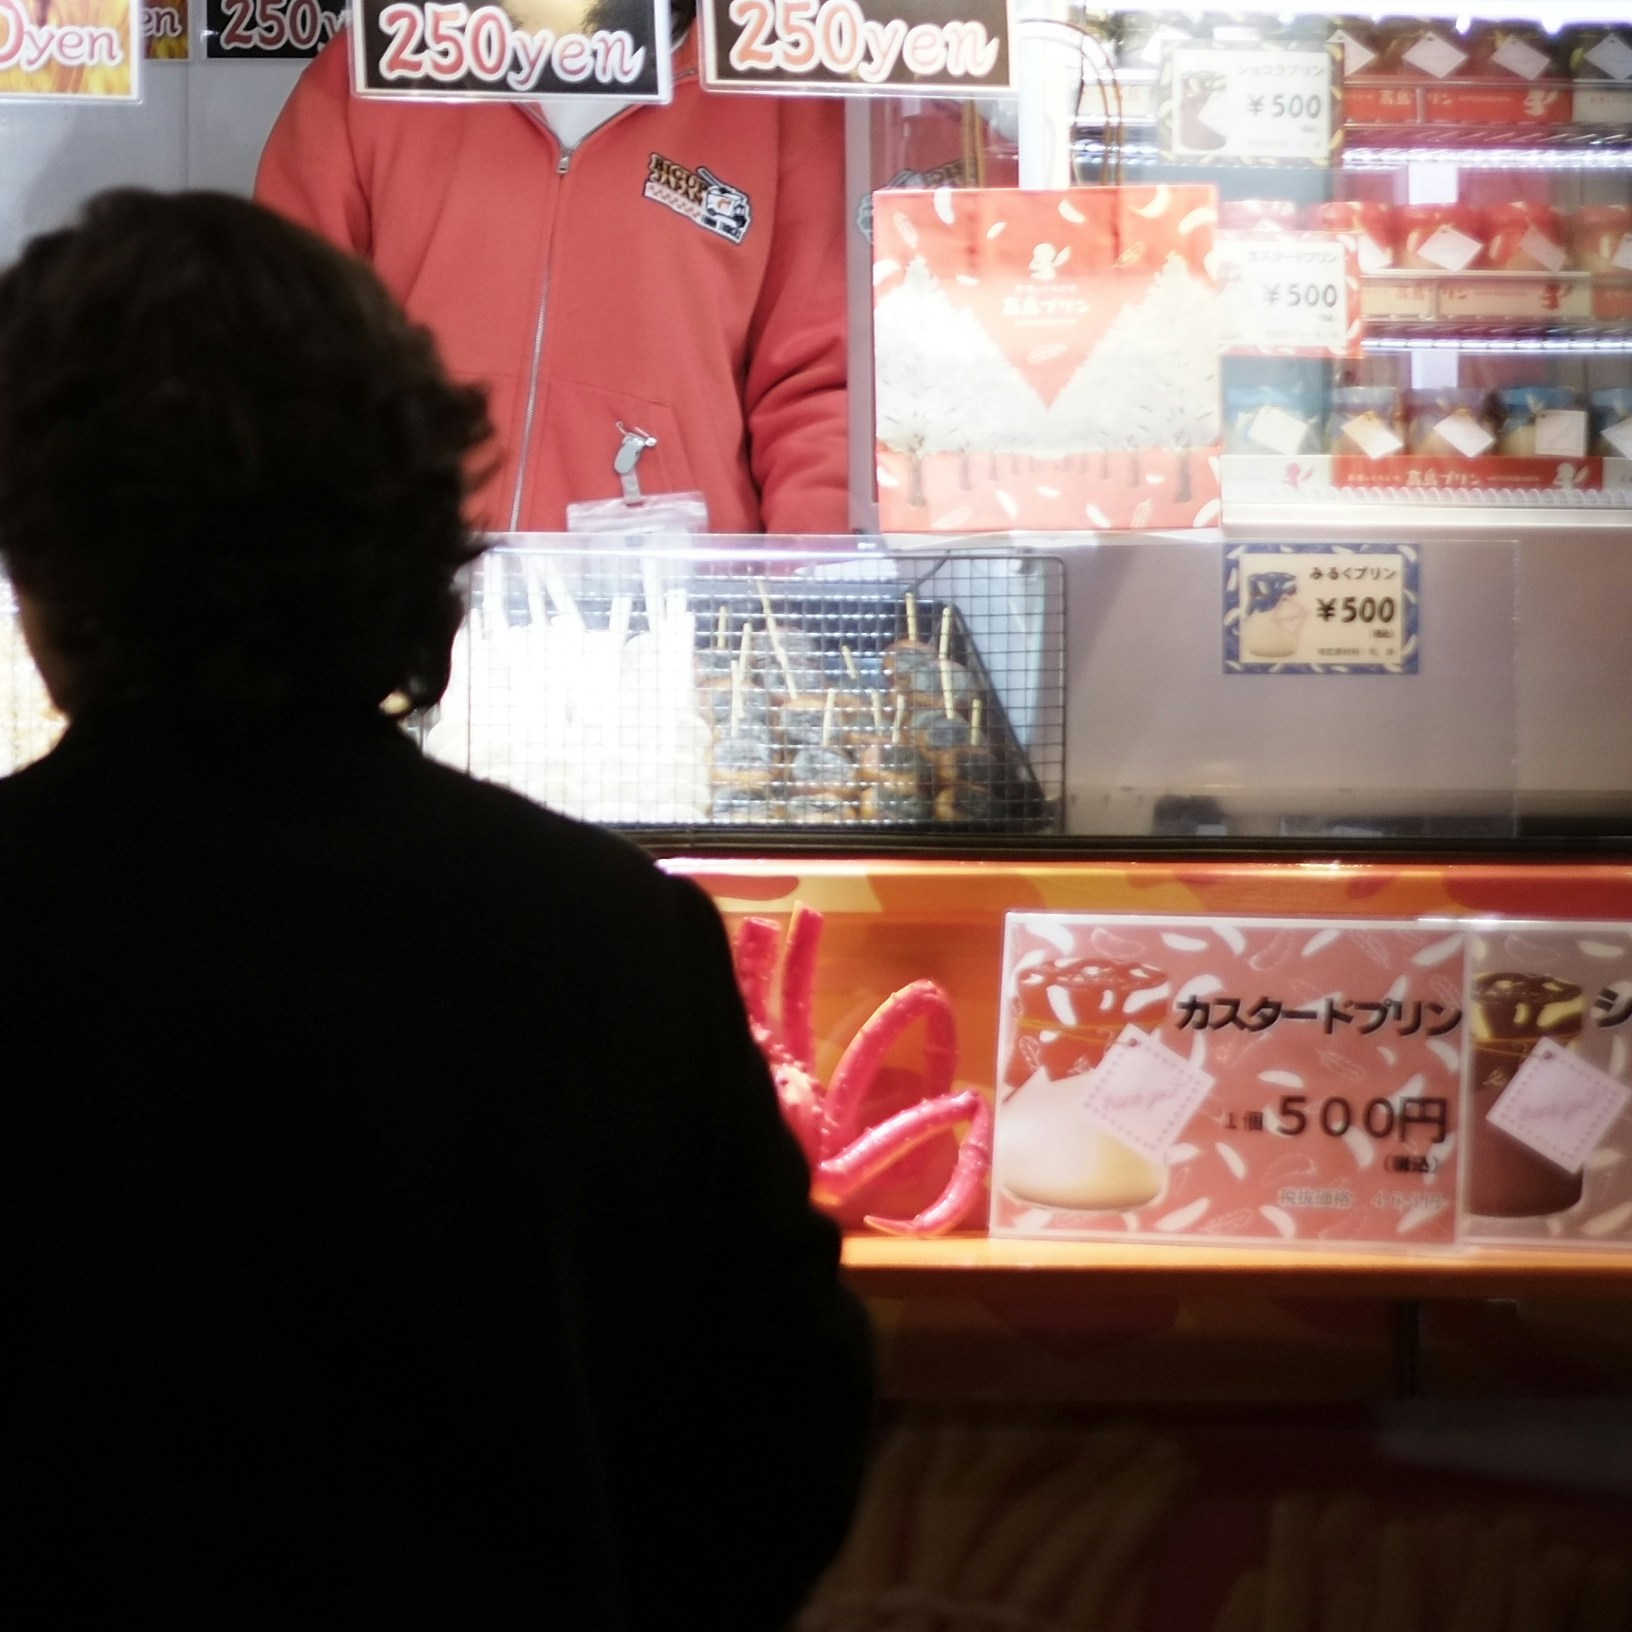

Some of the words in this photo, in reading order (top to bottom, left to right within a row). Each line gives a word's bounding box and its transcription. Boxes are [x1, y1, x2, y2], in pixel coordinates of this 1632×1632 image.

[378, 2, 647, 91] 250yen
[1245, 93, 1322, 120] ¥500
[1262, 282, 1338, 309] ¥500
[1315, 595, 1396, 624] ¥500
[1175, 993, 1463, 1037] カスタードプリン
